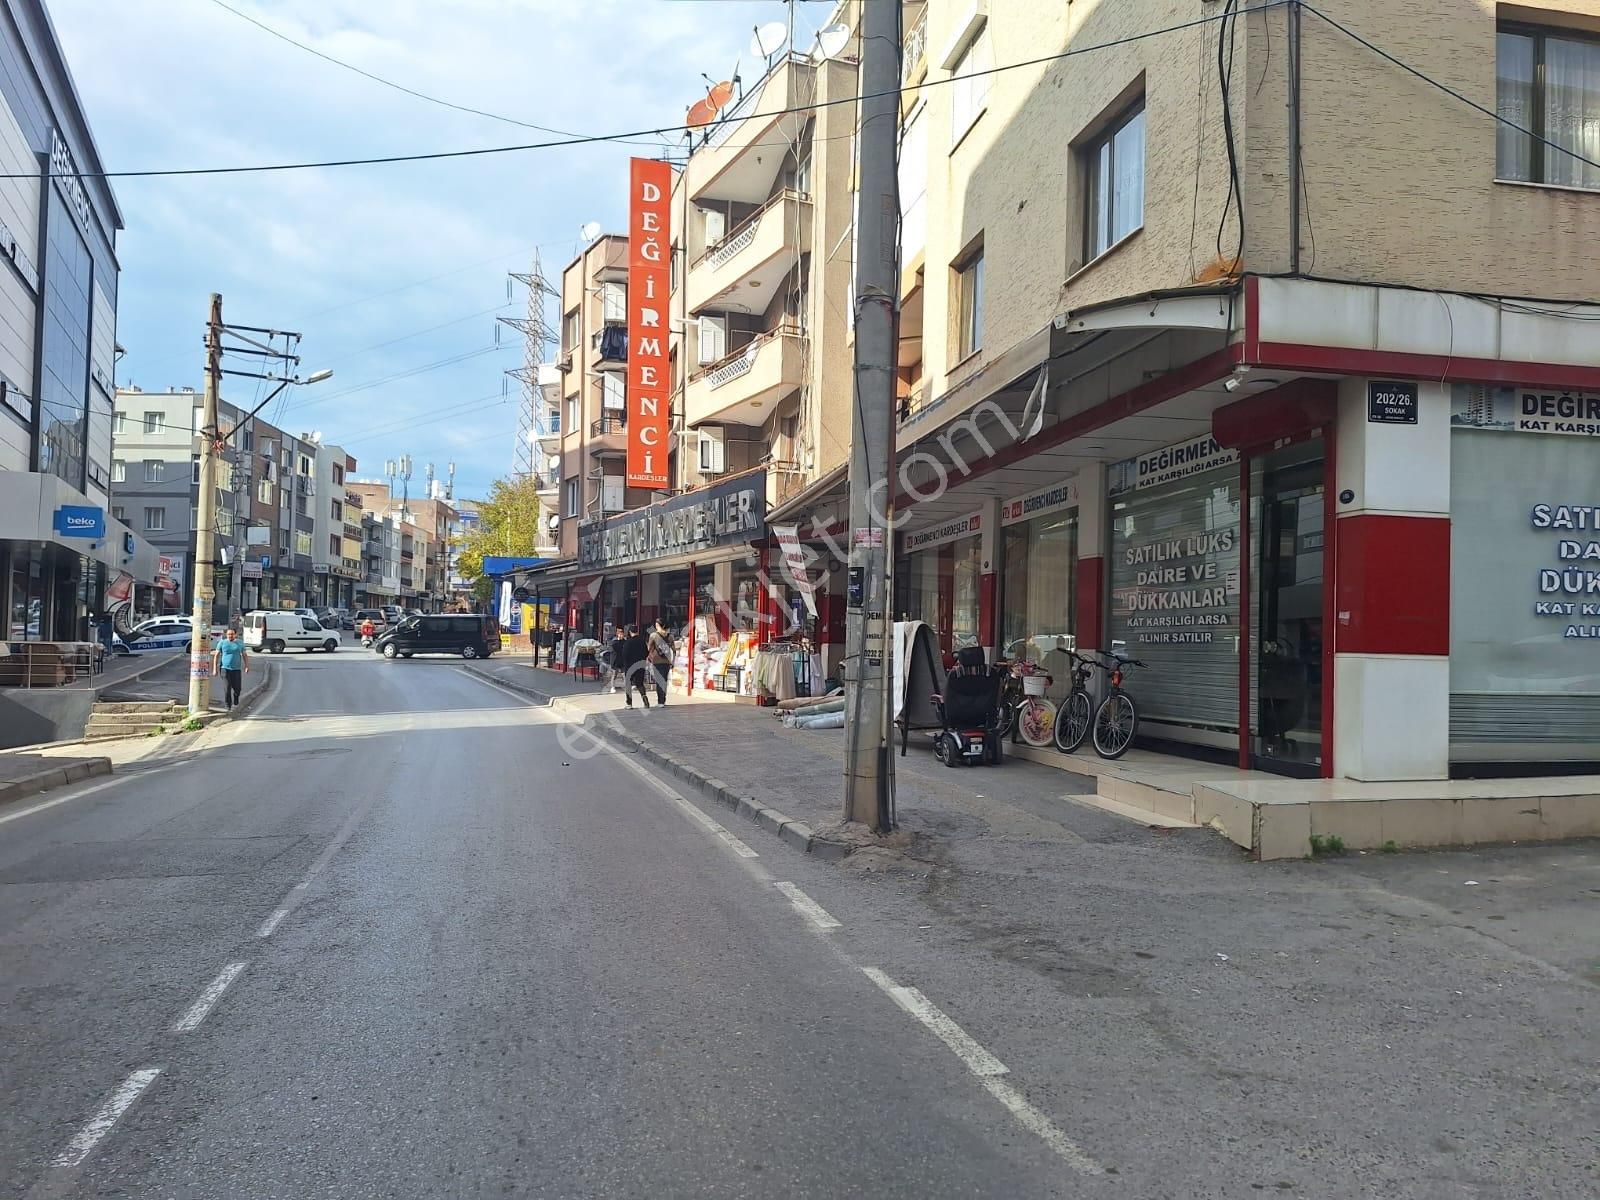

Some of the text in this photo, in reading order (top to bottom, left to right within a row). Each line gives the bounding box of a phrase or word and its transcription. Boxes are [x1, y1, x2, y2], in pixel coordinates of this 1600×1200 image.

[637, 182, 662, 474] DEĞİRMENCİ
[1384, 407, 1406, 415] SOKAK
[1520, 420, 1550, 431] KAT
[1139, 476, 1156, 488] KAT
[1205, 454, 1233, 470] ARSA
[67, 516, 96, 525] beko
[1126, 530, 1233, 566] SATILIK LÜKS
[1137, 562, 1217, 586] DAİRE VE
[1128, 586, 1227, 611] DÜKKANLAR
[1535, 601, 1576, 615] KAT
[1127, 617, 1145, 628] KAT
[1197, 614, 1229, 626] ARSA
[1139, 631, 1213, 643] ALINIR SATILIR
